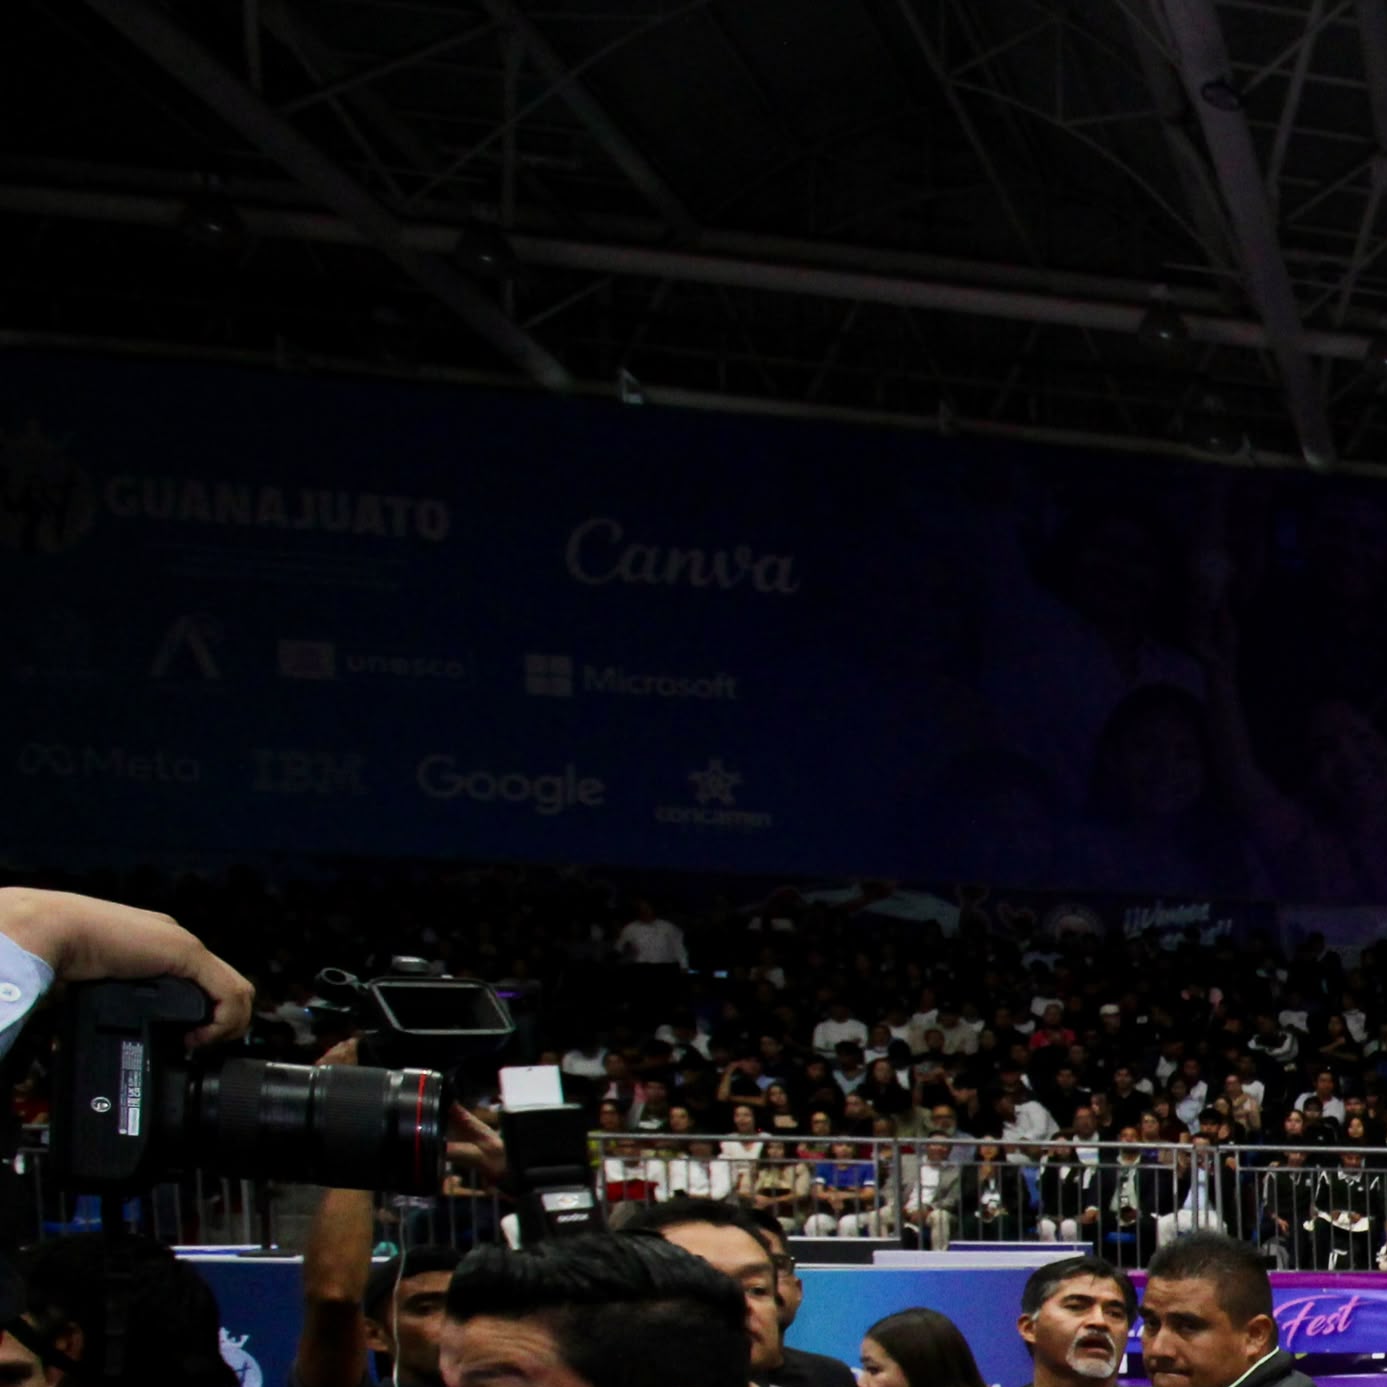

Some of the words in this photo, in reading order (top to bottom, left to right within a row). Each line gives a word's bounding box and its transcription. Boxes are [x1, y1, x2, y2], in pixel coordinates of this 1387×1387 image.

[102, 473, 450, 543] GUANAJUATO
[565, 515, 801, 595] Canva
[346, 652, 466, 681] unesco
[582, 664, 738, 701] Microsoft
[249, 748, 370, 796] IBM
[415, 752, 607, 816] Google
[1273, 1294, 1370, 1348] Fest
